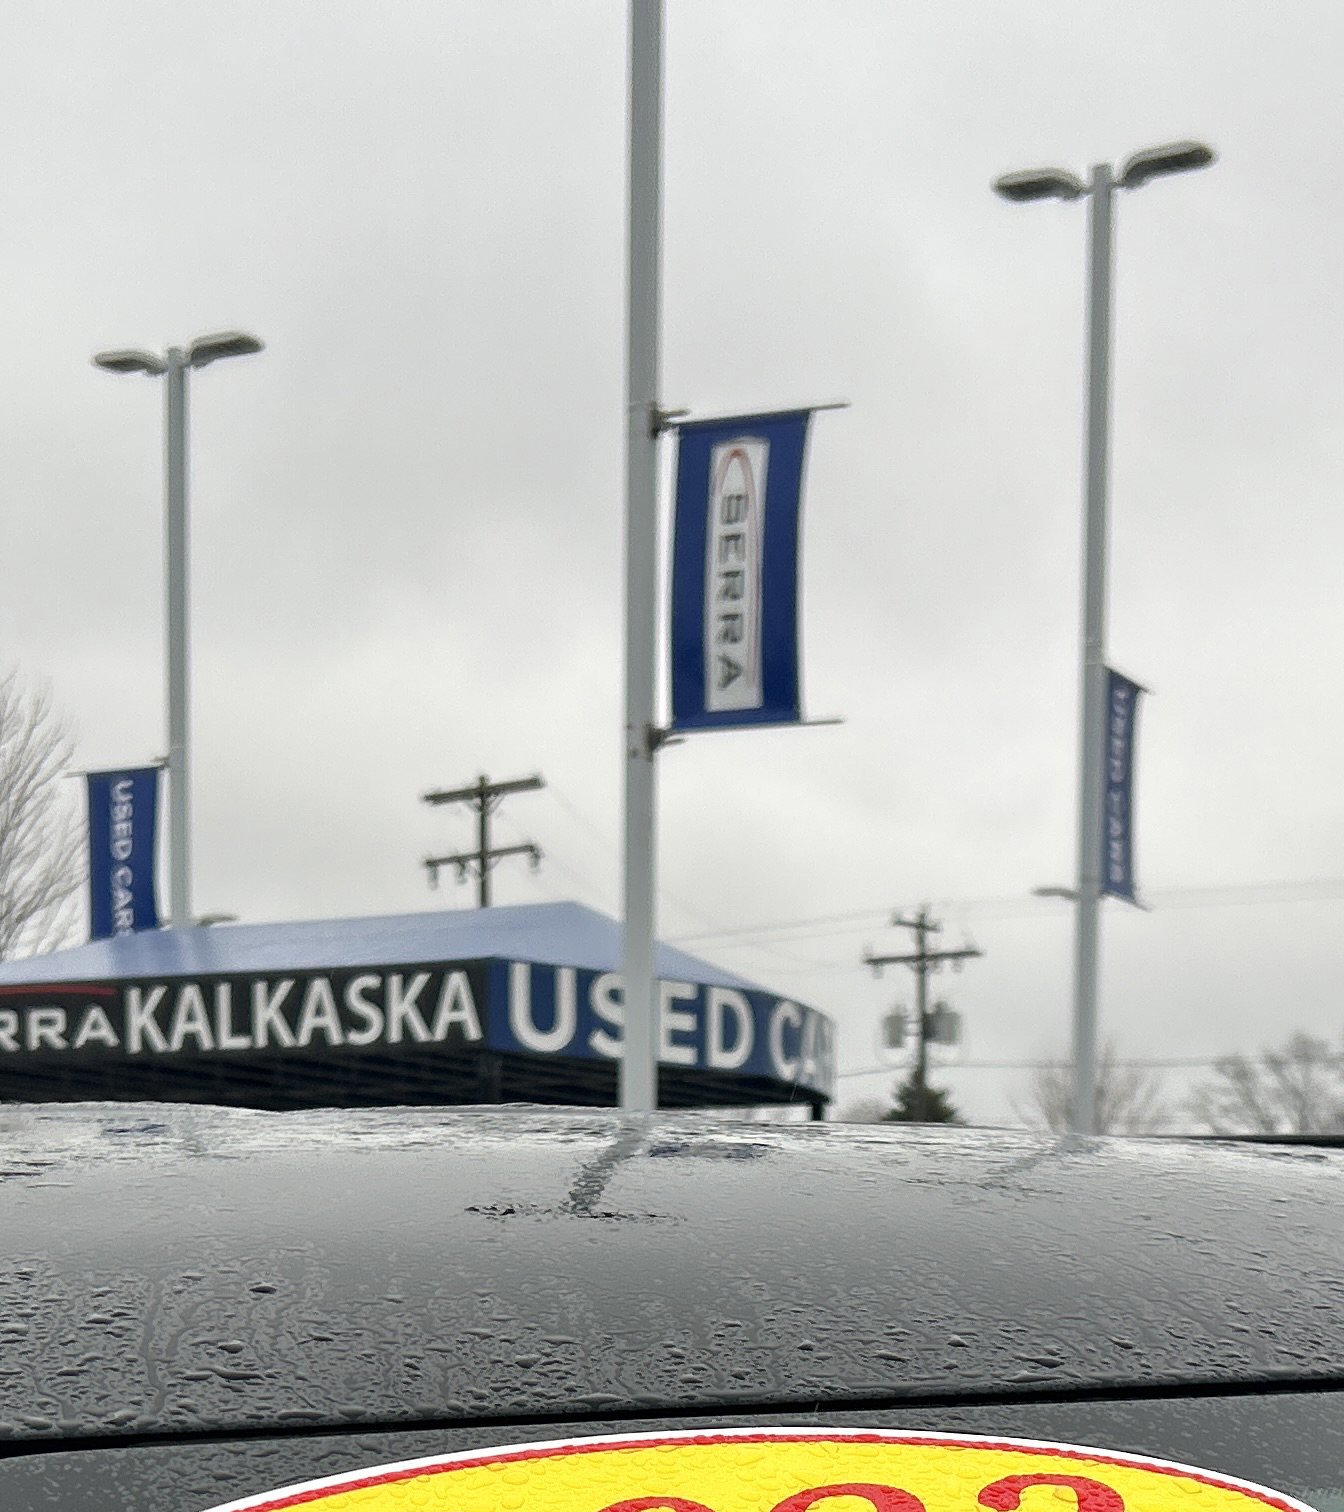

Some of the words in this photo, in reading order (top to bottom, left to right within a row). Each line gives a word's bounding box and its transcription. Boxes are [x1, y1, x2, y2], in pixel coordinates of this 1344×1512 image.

[718, 494, 748, 690] SERRA
[111, 779, 134, 861] USED
[124, 969, 482, 1054] KALKASKA
[509, 961, 755, 1069] USED
